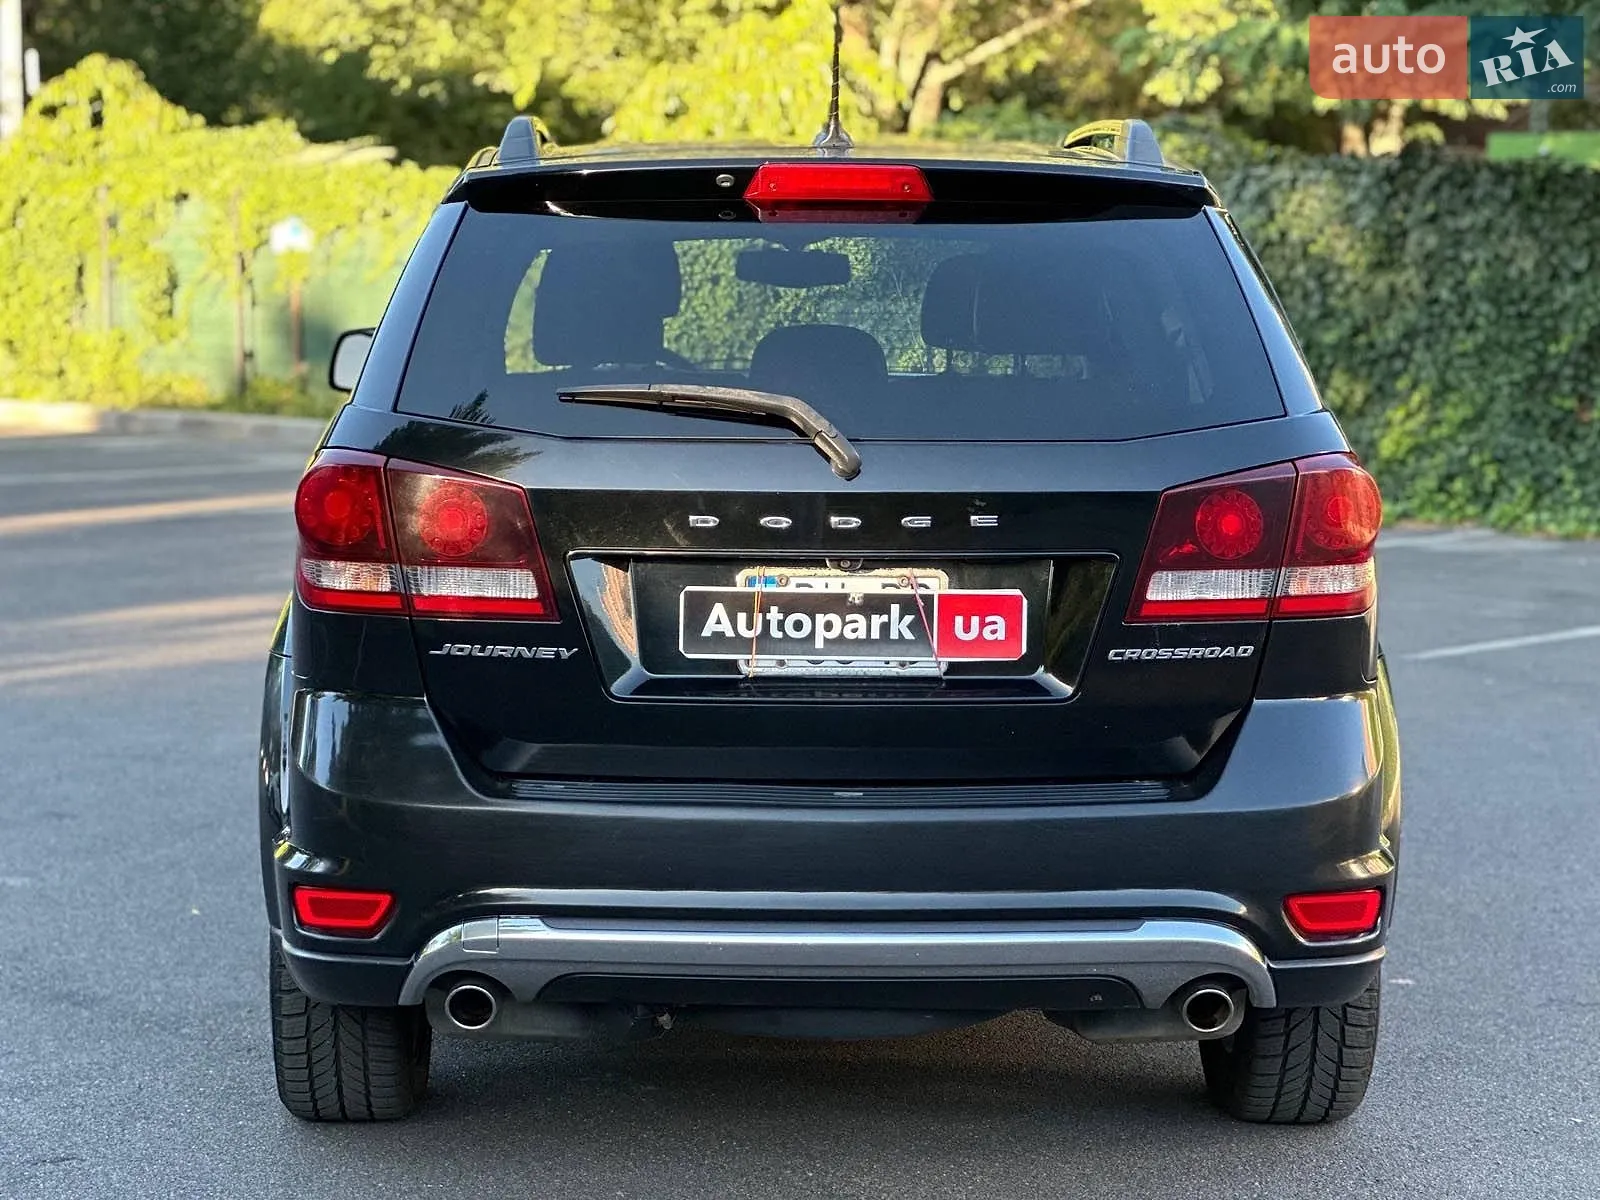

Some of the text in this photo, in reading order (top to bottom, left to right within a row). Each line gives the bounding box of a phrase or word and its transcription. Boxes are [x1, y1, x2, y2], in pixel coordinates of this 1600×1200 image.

[688, 515, 999, 528] DODGE
[700, 602, 1007, 649] Autopark ua
[428, 643, 578, 660] JOURNEY
[1107, 645, 1254, 661] CROSSROAD
